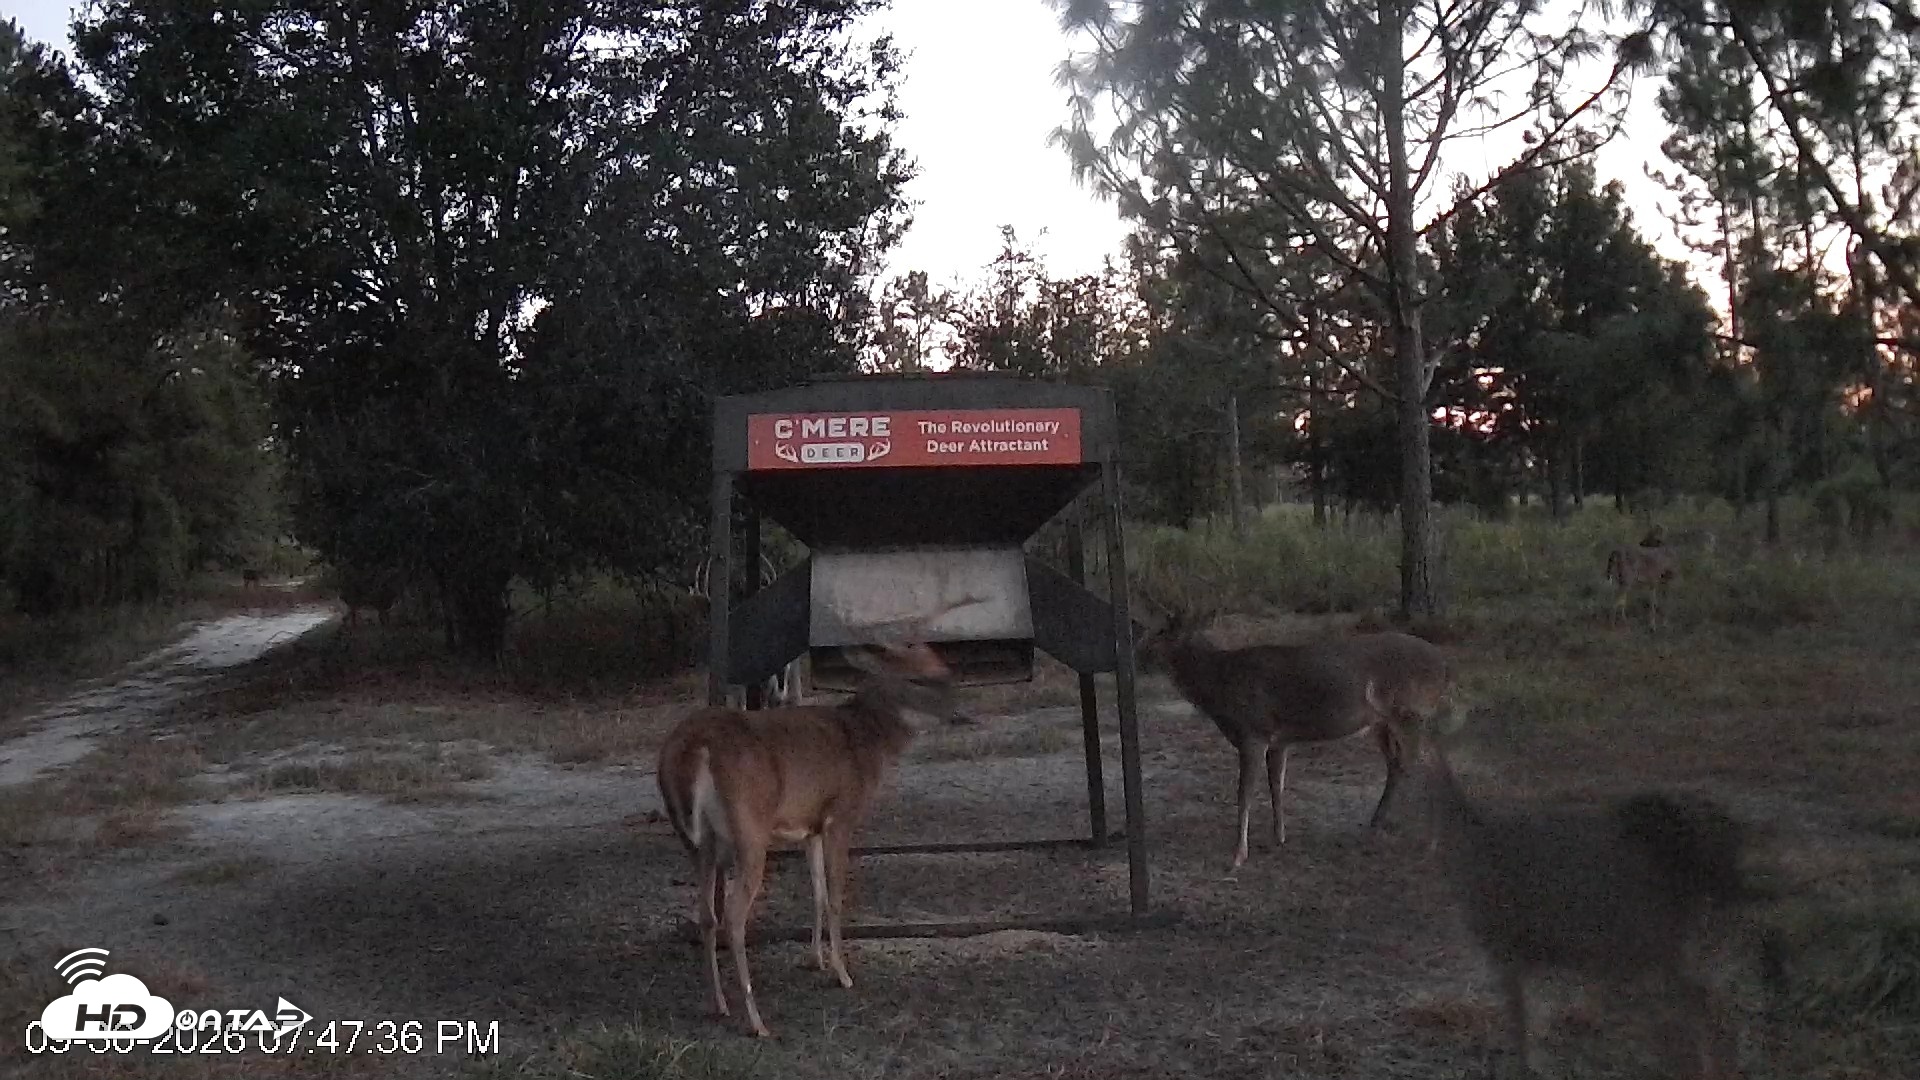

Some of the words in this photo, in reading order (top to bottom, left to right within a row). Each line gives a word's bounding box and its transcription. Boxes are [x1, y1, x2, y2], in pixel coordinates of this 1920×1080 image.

[775, 416, 891, 439] C'MERE
[918, 421, 946, 434] The
[951, 419, 1060, 435] Revolutionary
[807, 447, 859, 459] DEER
[927, 439, 965, 453] Deer
[968, 438, 1050, 452] Attractant
